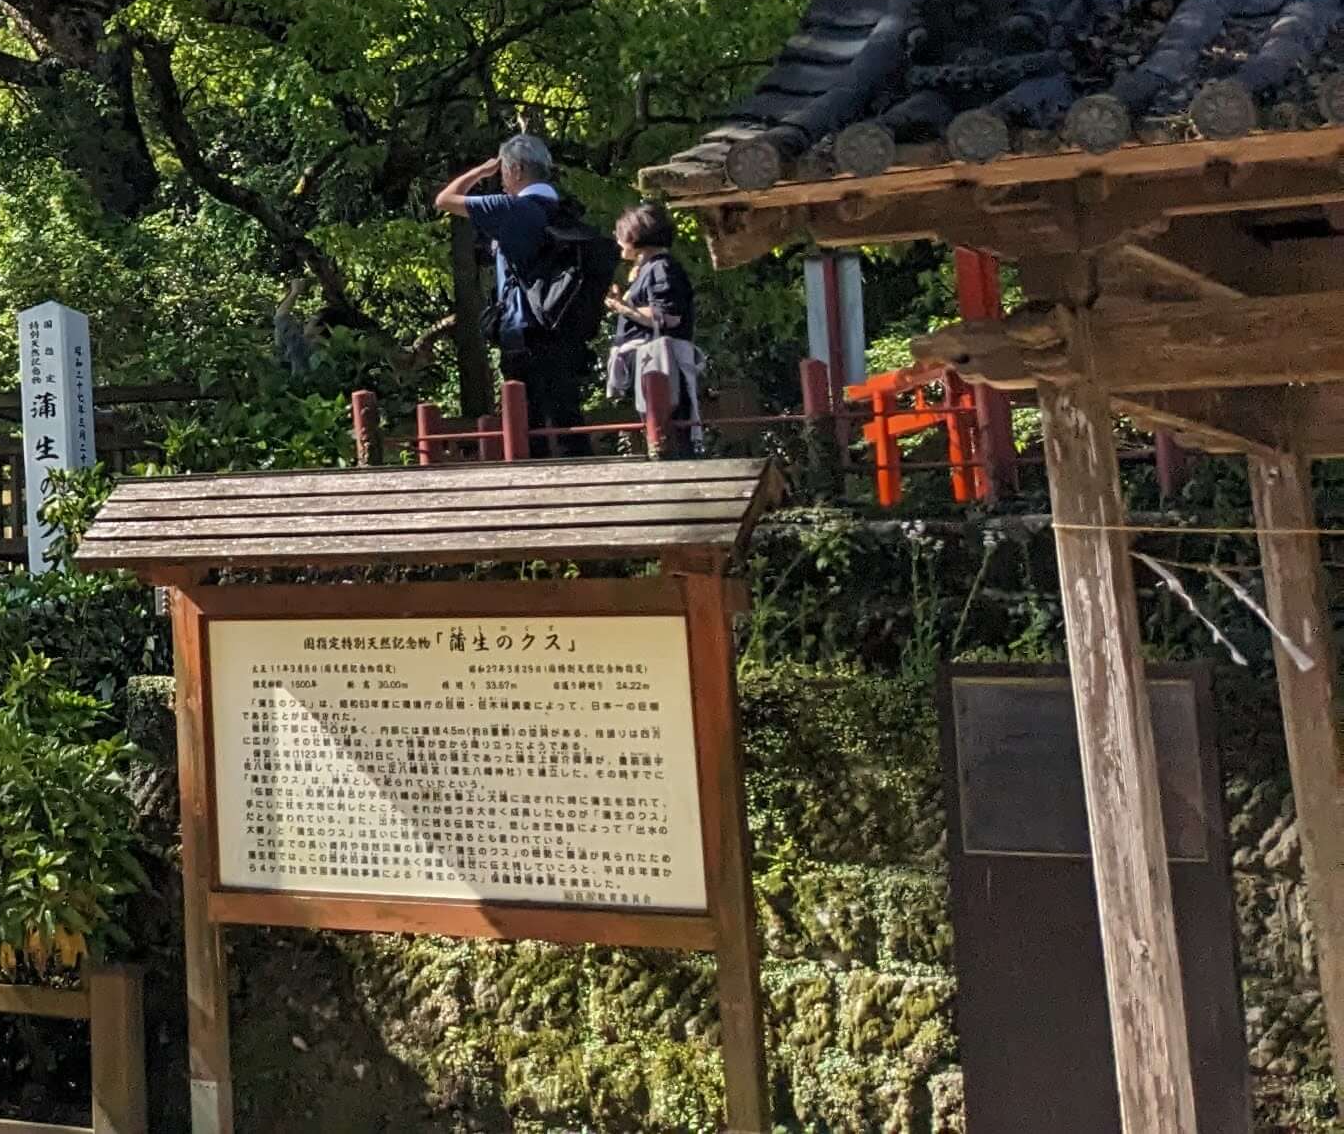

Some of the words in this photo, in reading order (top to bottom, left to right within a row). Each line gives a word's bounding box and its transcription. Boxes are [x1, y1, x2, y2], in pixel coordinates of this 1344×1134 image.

[74, 346, 88, 471] 昭和二十七年三月二十
